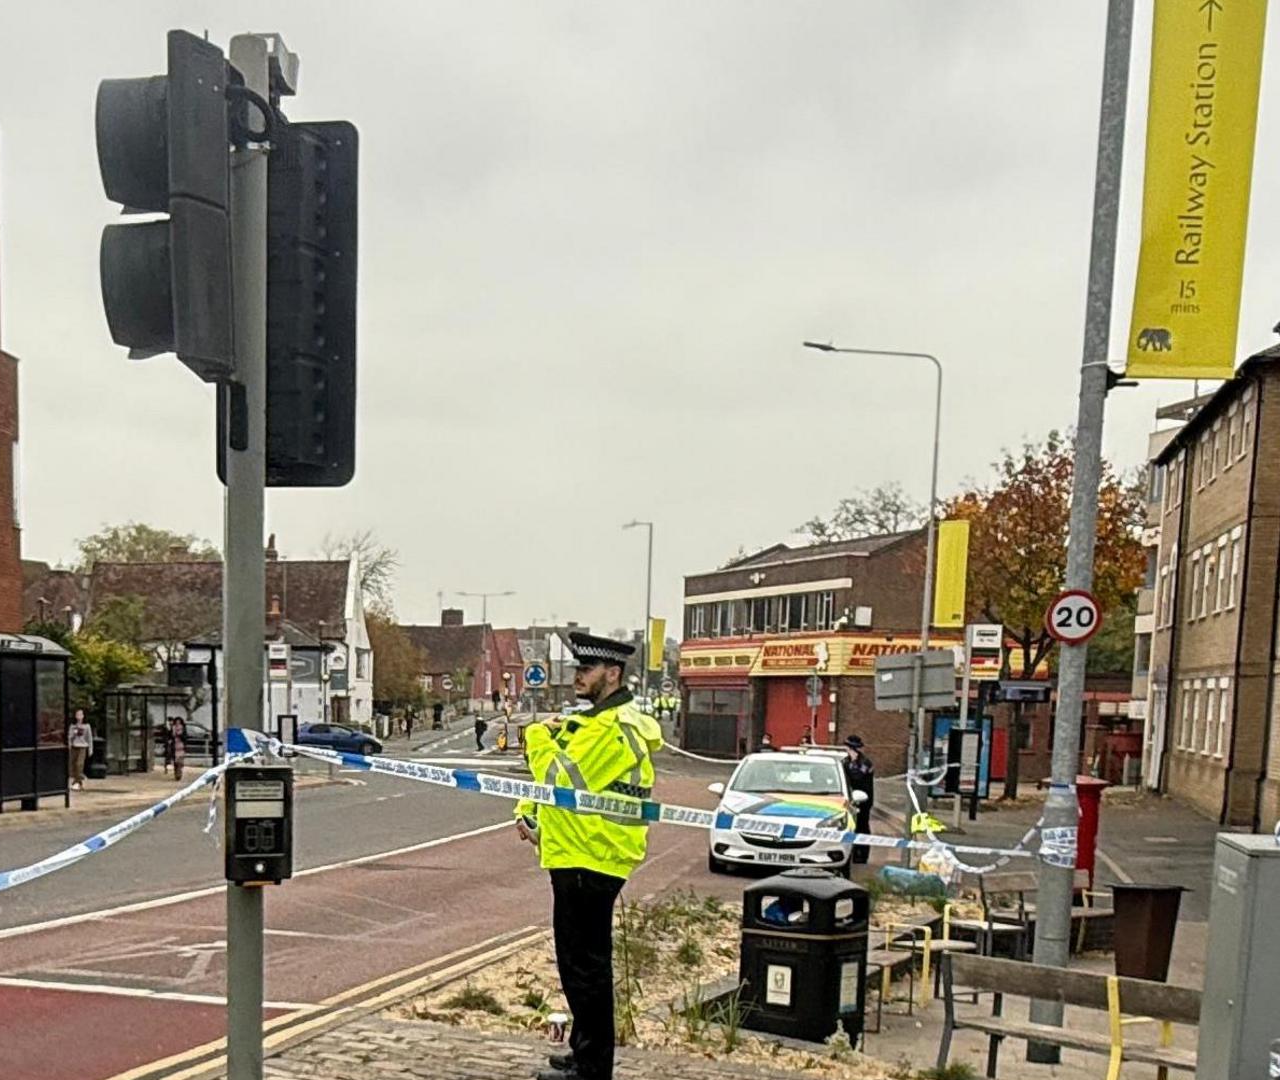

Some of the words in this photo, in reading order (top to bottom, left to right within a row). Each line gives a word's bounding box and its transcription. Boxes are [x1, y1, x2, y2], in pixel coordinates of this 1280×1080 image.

[1185, 43, 1218, 146] Station
[1175, 154, 1216, 265] Railway
[1178, 279, 1196, 299] 15
[1170, 301, 1201, 314] mins
[1056, 606, 1095, 628] 20
